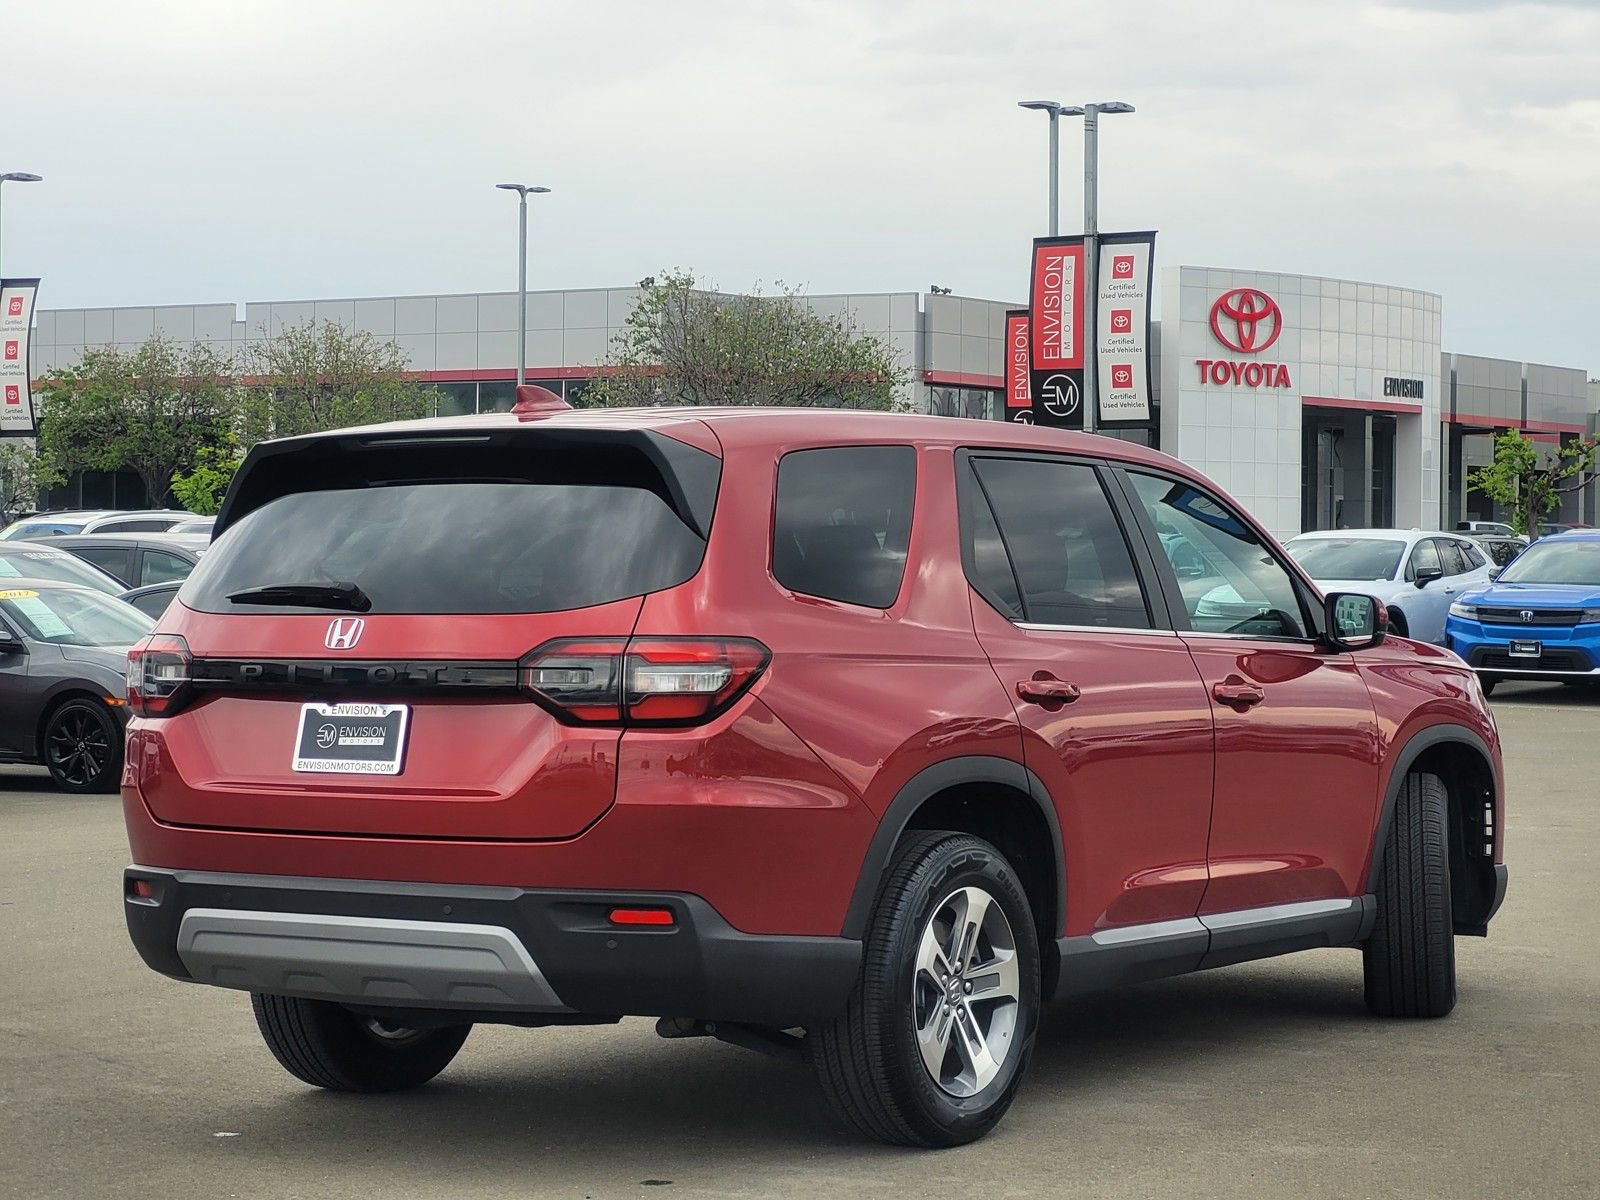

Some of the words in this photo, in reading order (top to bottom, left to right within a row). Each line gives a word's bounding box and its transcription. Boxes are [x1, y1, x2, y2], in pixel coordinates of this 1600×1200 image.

[1043, 256, 1063, 360] ENVISION
[1063, 264, 1073, 350] MOTORS
[1014, 323, 1028, 400] ENVISION
[1196, 359, 1292, 389] TOYOTA
[1383, 376, 1425, 400] ENVISION
[239, 663, 449, 684] PILOT
[331, 705, 378, 716] ENVISION
[339, 726, 387, 737] ENVISION
[297, 761, 395, 773] ENVISIONMOTORS.COM
